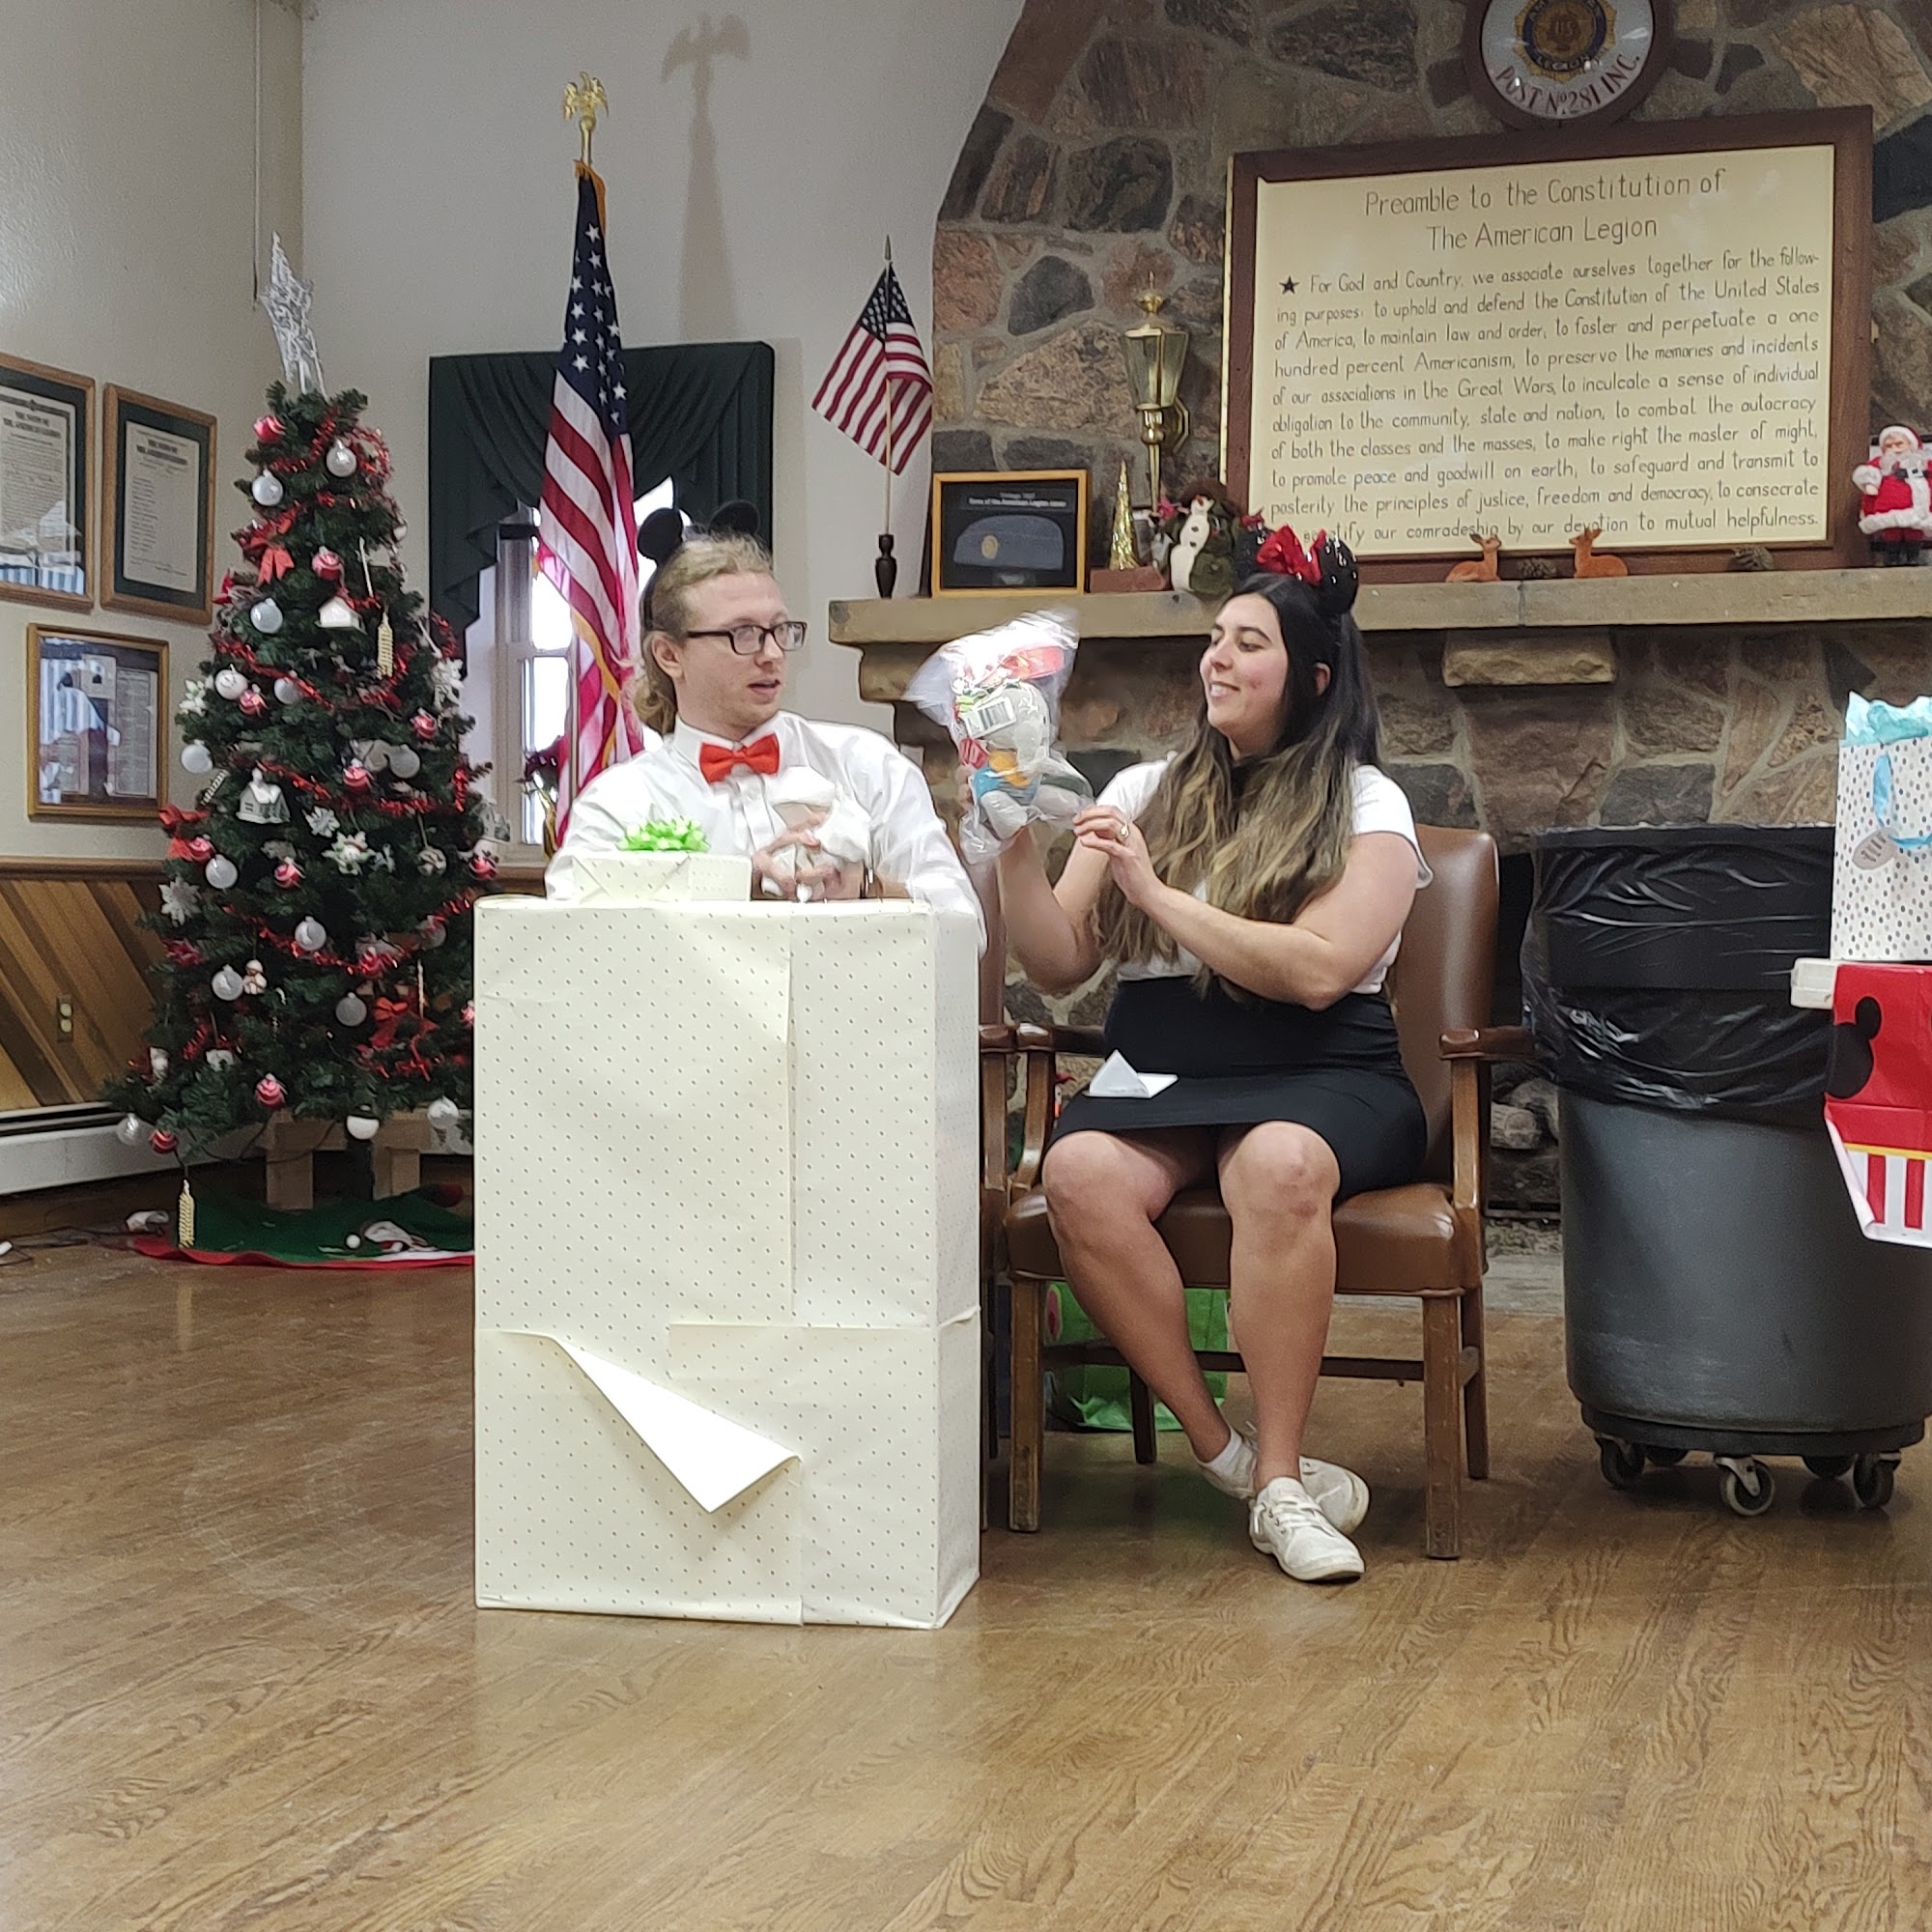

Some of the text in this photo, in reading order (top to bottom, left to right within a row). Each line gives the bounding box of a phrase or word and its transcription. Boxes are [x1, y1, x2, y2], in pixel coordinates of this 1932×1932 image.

[1495, 65, 1544, 109] POST
[1600, 53, 1641, 95] INC.
[1366, 168, 1725, 216] Preamble to the Constitution of
[1427, 216, 1657, 251] The American Legion
[1311, 274, 1331, 293] For
[1339, 272, 1364, 292] God
[1374, 270, 1398, 290] and
[1473, 273, 1493, 285] we
[1501, 262, 1563, 282] associate
[1574, 258, 1635, 278] ourselves
[1648, 253, 1713, 278] together
[1723, 249, 1742, 270] for
[1750, 247, 1775, 268] the
[1277, 312, 1296, 327] ing
[1375, 299, 1387, 318] to
[1393, 297, 1436, 322] uphold
[1444, 297, 1467, 314] and
[1477, 291, 1524, 312] defend
[1536, 292, 1558, 309] the
[1565, 286, 1647, 307] Constitution
[1656, 283, 1670, 301] of
[1679, 282, 1705, 300] the
[1716, 277, 1766, 298] United
[1776, 275, 1819, 295] States
[1275, 307, 1819, 350] of America, to maintain law and order, to foster and perpetuate a one
[1275, 332, 1818, 381] hundred percent Americanism, to preserve the memories and incidents
[1273, 360, 1818, 405] of our associations in the Great Wars, to inculcate a sense of individual
[1273, 413, 1332, 437] obligation
[1341, 412, 1353, 430] to
[1360, 410, 1382, 429] the
[1481, 405, 1517, 424] state
[1523, 403, 1548, 422] and
[1556, 402, 1605, 420] nation,
[1616, 400, 1629, 418] to
[1638, 396, 1696, 417] combat
[1709, 395, 1733, 413] the
[1741, 392, 1816, 413] autocracy
[1271, 440, 1286, 459] of
[1292, 440, 1322, 459] both
[1330, 440, 1354, 457] the
[1361, 438, 1410, 456] classes
[1419, 436, 1443, 453] and
[1454, 435, 1475, 452] the
[1546, 431, 1559, 449] to
[1568, 428, 1605, 447] make
[1612, 427, 1648, 451] right
[1658, 425, 1682, 444] the
[1689, 423, 1739, 441] master
[1750, 420, 1767, 440] of
[1273, 447, 1818, 494] to promote peace and goodwill on earth, to safeguard and transmit to
[1271, 495, 1334, 522] posterity
[1345, 494, 1368, 513] the
[1377, 492, 1448, 519] principles
[1457, 489, 1472, 507] of
[1476, 490, 1528, 514] justice,
[1538, 485, 1600, 505] freedom
[1608, 483, 1633, 502] and
[1718, 479, 1730, 498] to
[1737, 477, 1818, 497] consecrate
[1374, 526, 1398, 540] our
[1406, 517, 1498, 537] comradeship
[1508, 516, 1523, 542] by
[1532, 524, 1554, 533] our
[1564, 512, 1628, 532] devotion
[1639, 511, 1655, 530] to
[1665, 508, 1716, 530] mutual
[1727, 506, 1818, 536] helpfulness.
